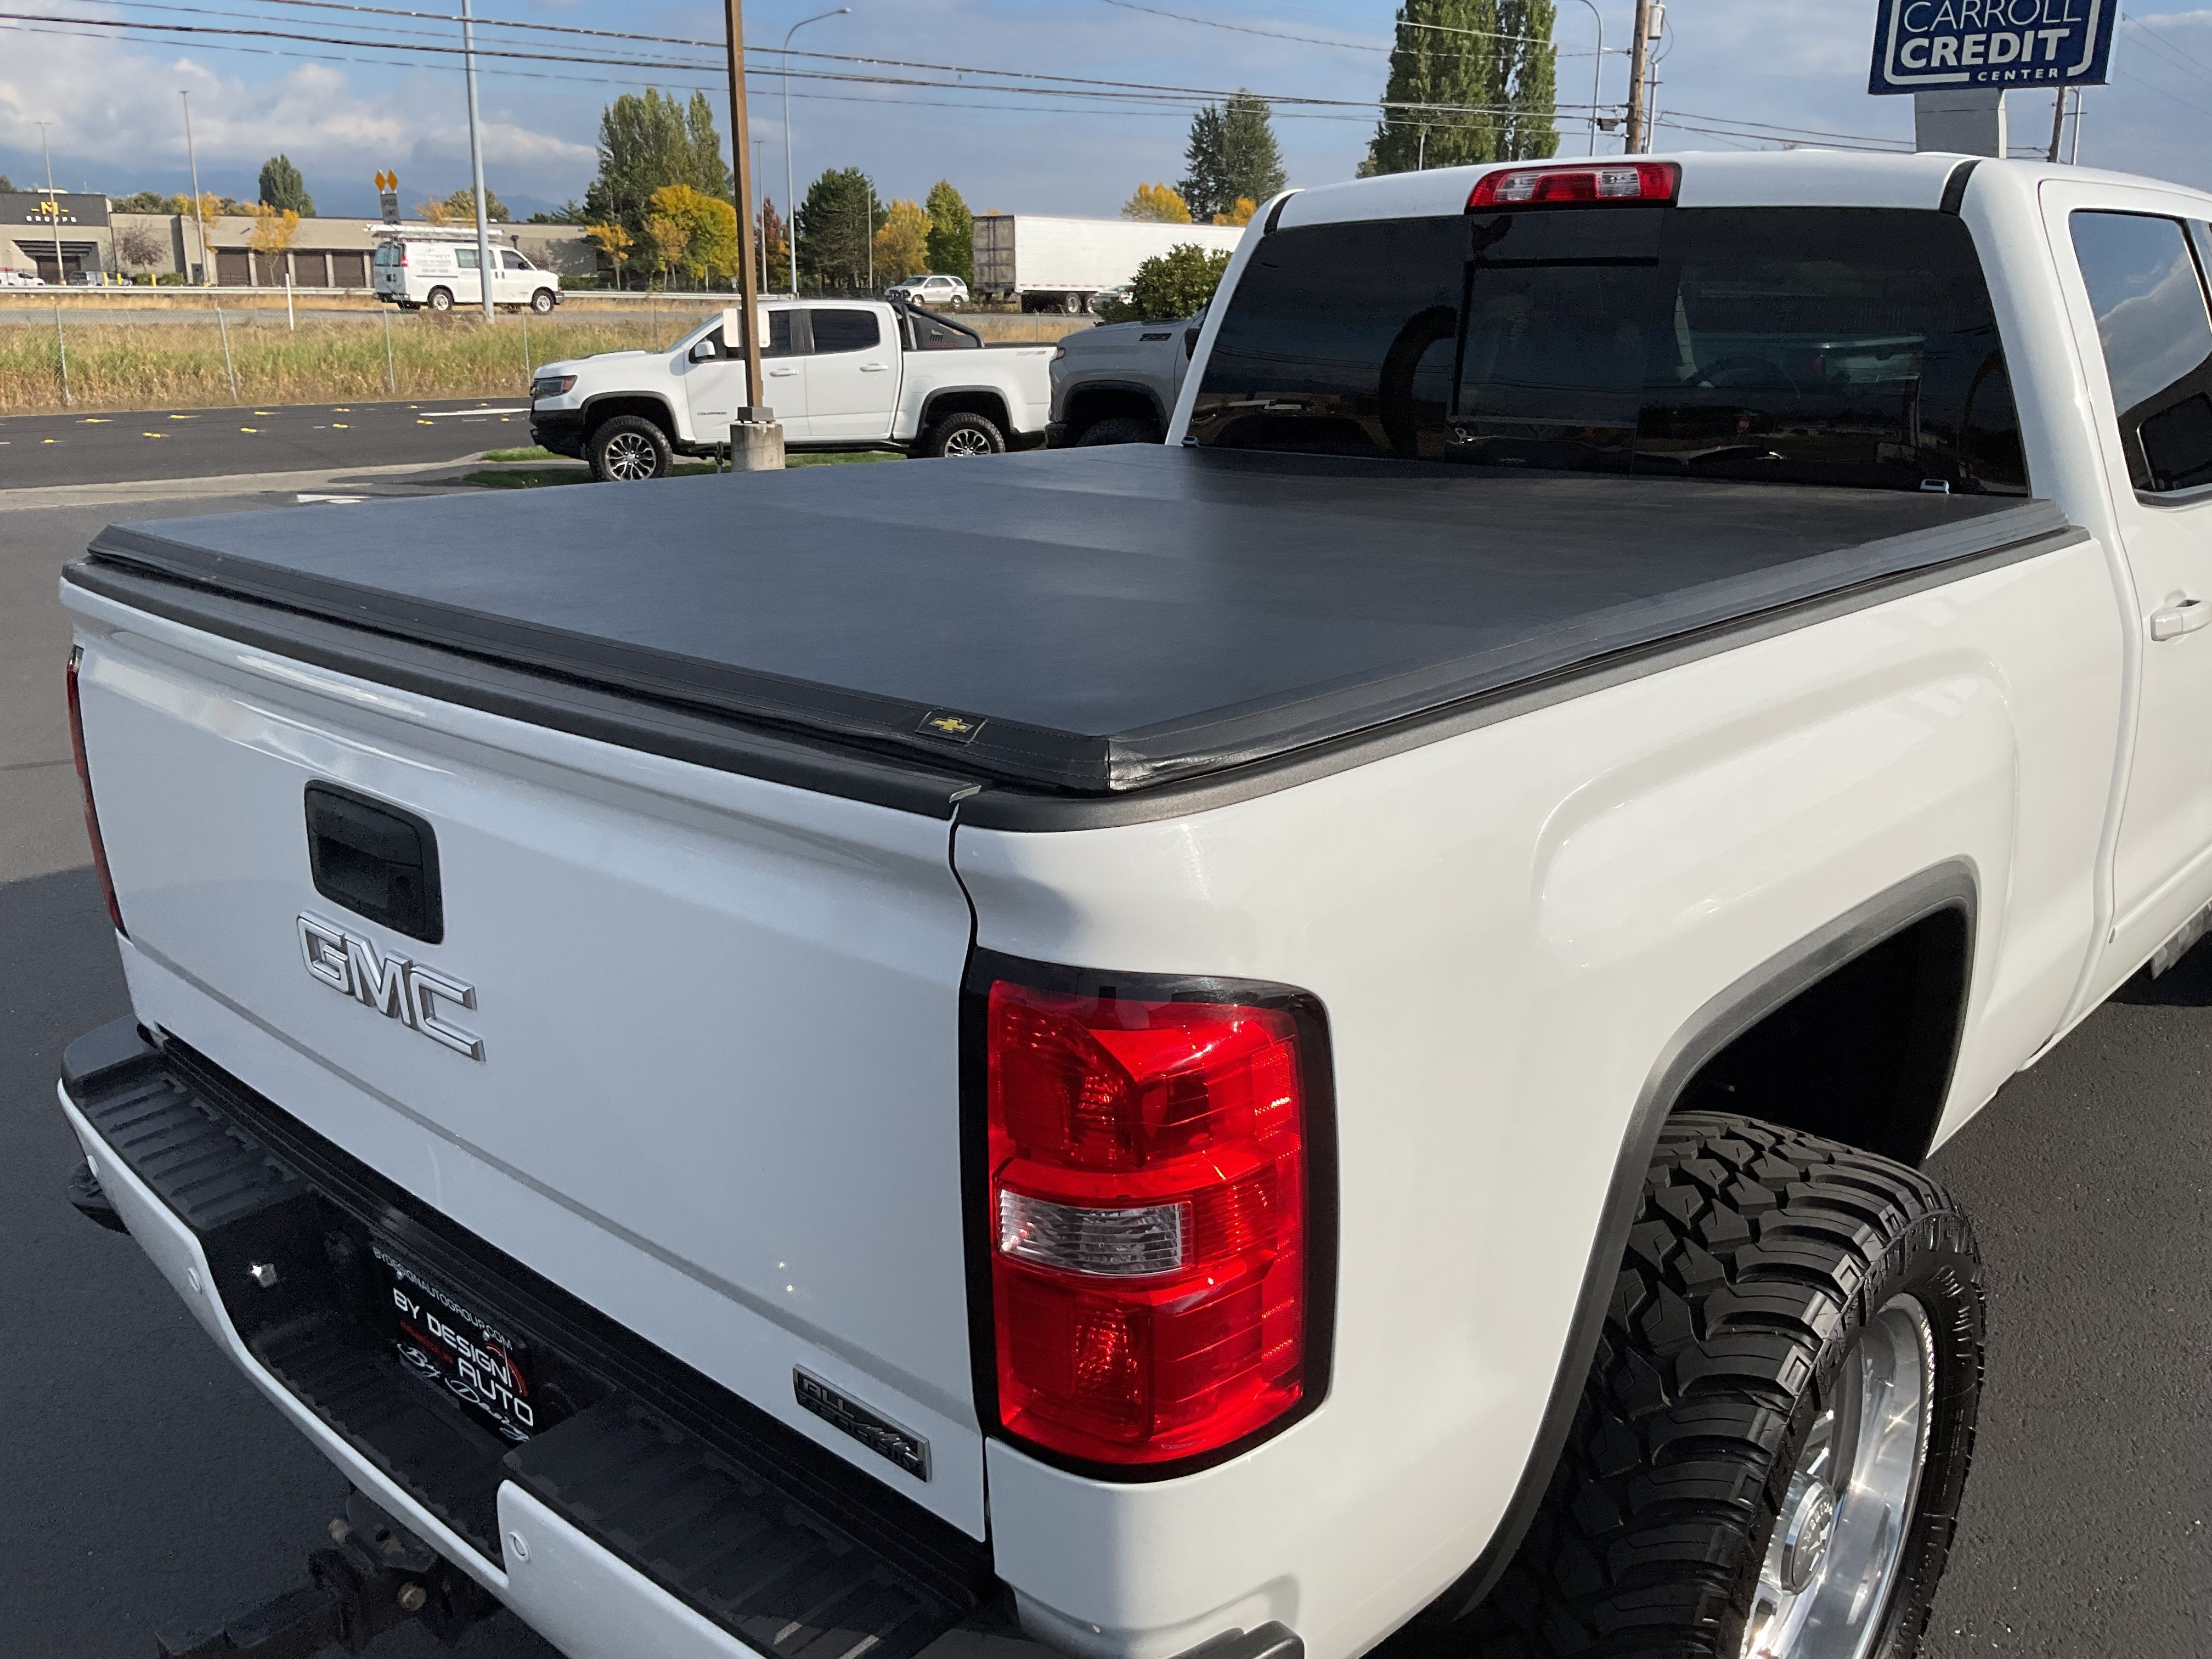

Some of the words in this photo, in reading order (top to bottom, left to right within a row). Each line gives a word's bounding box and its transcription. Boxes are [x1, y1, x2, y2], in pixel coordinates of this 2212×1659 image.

[1904, 0, 2082, 33] CARROLL
[1900, 27, 2070, 69] CREDIT
[1977, 67, 2058, 81] CENTER
[297, 910, 486, 1062] GMC
[393, 1287, 420, 1319] BY
[426, 1312, 510, 1386] DESIGN
[457, 1357, 534, 1426] AUTO
[803, 1378, 854, 1418] ALL
